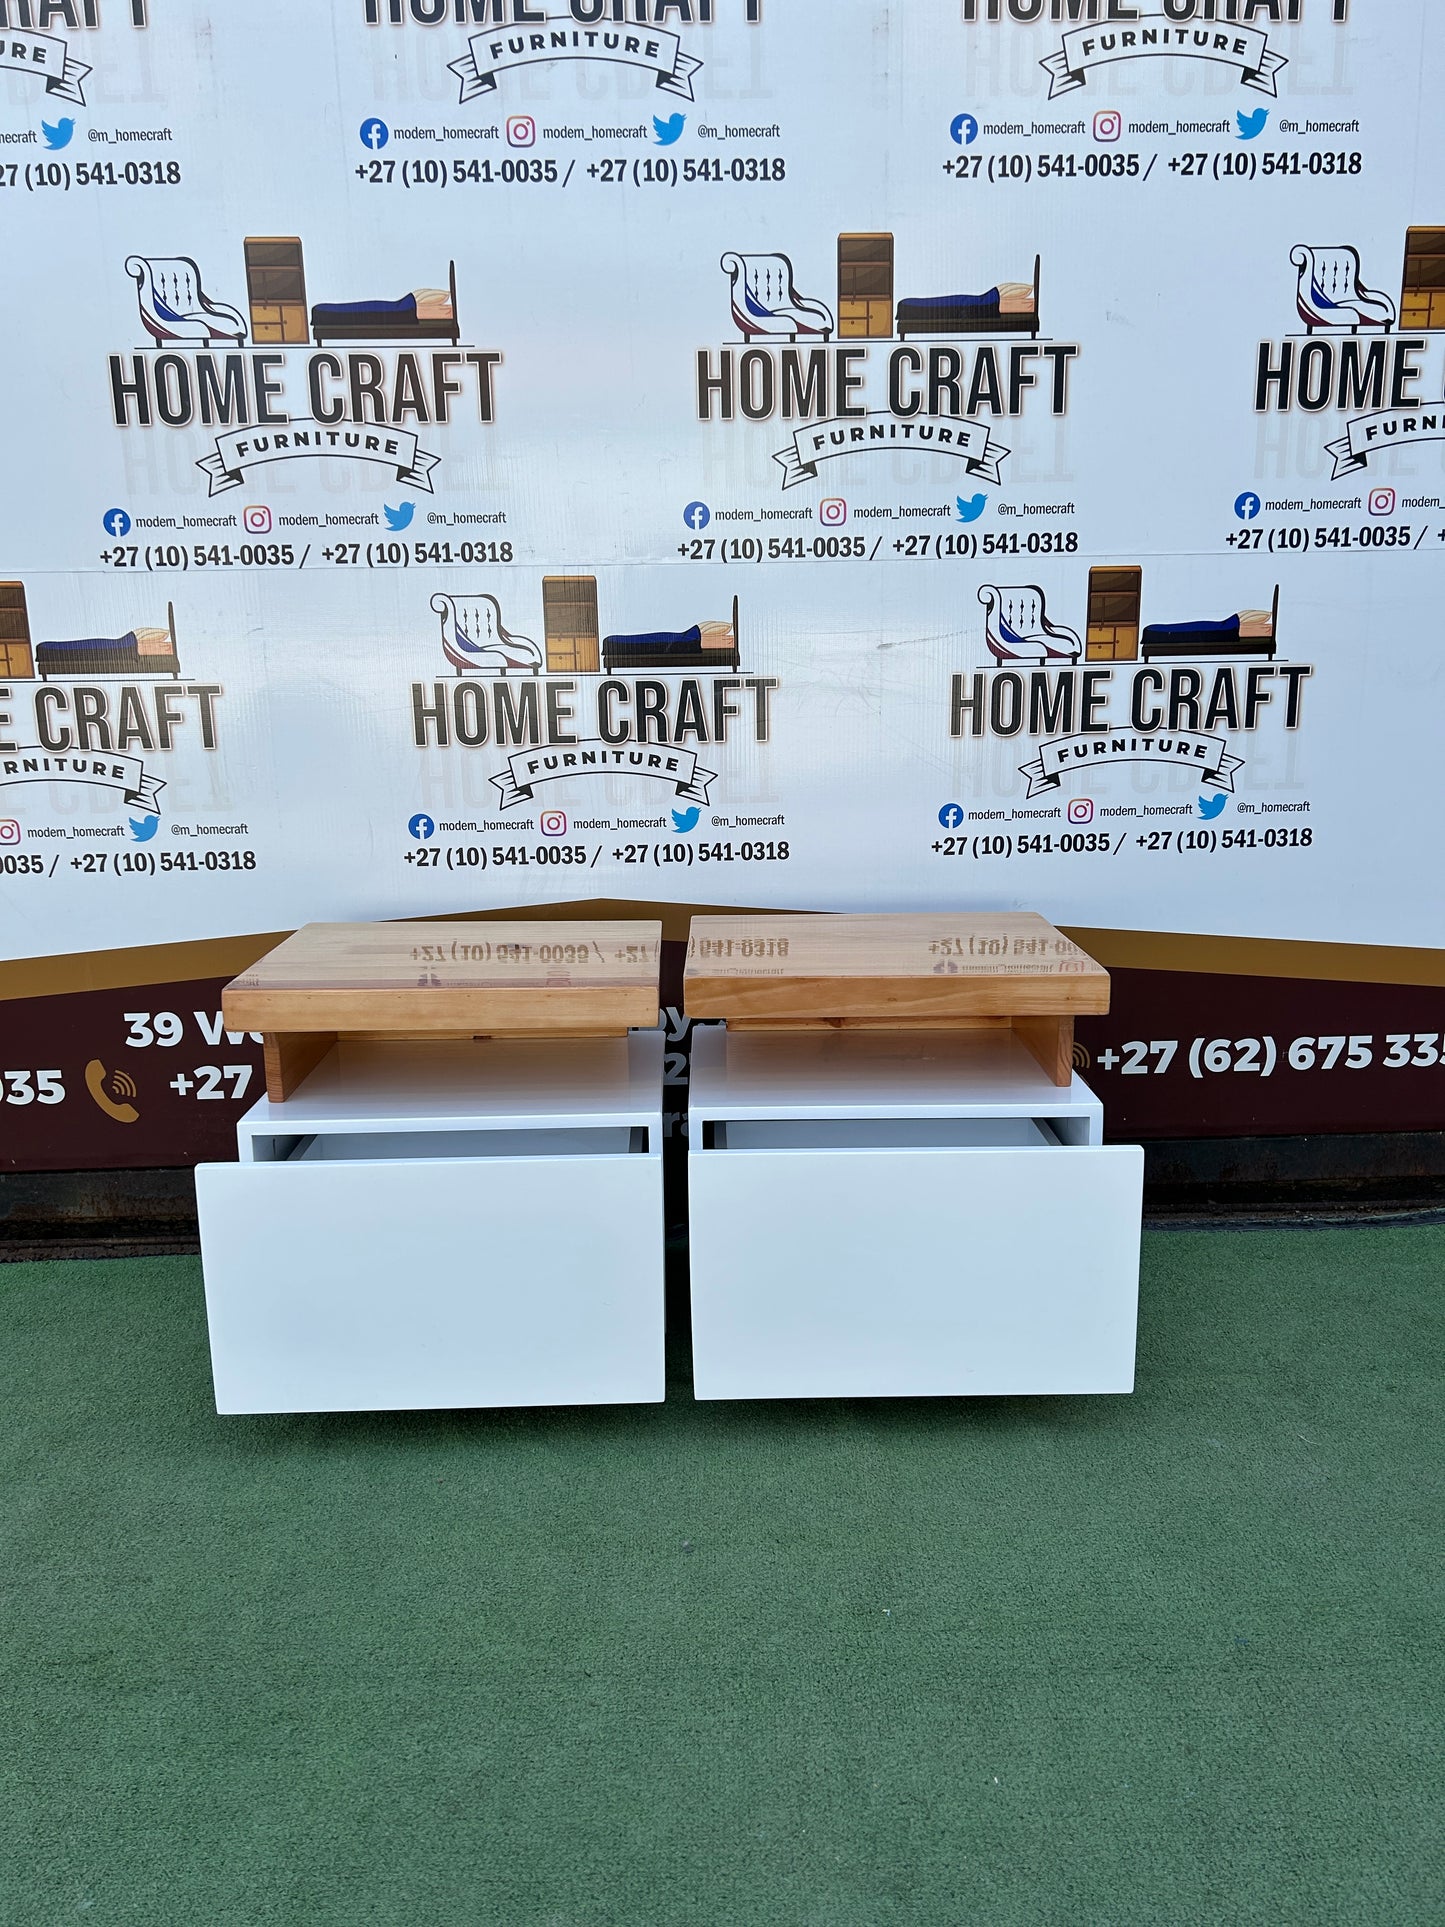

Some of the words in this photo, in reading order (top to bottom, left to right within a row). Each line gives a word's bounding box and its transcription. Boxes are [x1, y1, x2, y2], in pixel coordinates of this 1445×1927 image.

[489, 31, 660, 59] FURNITURE
[1082, 28, 1248, 56] FURNITURE
[88, 128, 172, 144] @m_homecraft
[698, 124, 780, 140] @m_homecraft
[1280, 120, 1359, 134] @m_homecraft
[25, 163, 70, 191] (10)
[76, 162, 180, 185] 541-0318
[355, 160, 395, 183] +27
[403, 160, 447, 188] (10)
[453, 160, 557, 183] 541-0035
[562, 160, 575, 187] /
[587, 159, 627, 182] +27
[633, 159, 677, 187] (10)
[683, 158, 785, 181] 541-0318
[943, 156, 982, 178] +27
[988, 155, 1031, 183] (10)
[1038, 154, 1139, 177] 541-0035
[1143, 154, 1158, 181] /
[1168, 153, 1208, 175] +27
[1213, 153, 1256, 180] (10)
[1262, 152, 1361, 175] 541-0318
[108, 353, 290, 426] HOME
[307, 351, 501, 424] CRAFT
[696, 348, 867, 420] HOME
[888, 345, 1078, 417] CRAFT
[1254, 339, 1427, 412] HOME
[236, 431, 399, 457] FURNITURE
[813, 424, 971, 451] FURNITURE
[427, 512, 506, 526] @m_homecraft
[998, 503, 1074, 517] @m_homecraft
[678, 540, 715, 559] +27
[721, 539, 762, 563] (10)
[768, 537, 865, 558] 541-0035
[869, 536, 882, 560] /
[893, 535, 930, 555] +27
[936, 534, 977, 559] (10)
[983, 532, 1078, 554] 541-0318
[1226, 529, 1263, 549] +27
[1268, 528, 1309, 553] (10)
[1314, 526, 1410, 547] 541-0035
[1414, 526, 1428, 550] /
[100, 547, 138, 567] +27
[145, 546, 188, 571] (10)
[194, 545, 294, 566] 541-0035
[299, 544, 310, 569] /
[322, 544, 360, 564] +27
[367, 543, 409, 568] (10)
[415, 542, 513, 563] 541-0318
[411, 681, 578, 747] HOME
[597, 678, 777, 745] CRAFT
[949, 670, 1111, 737] HOME
[1129, 665, 1311, 732] CRAFT
[33, 685, 222, 752] CRAFT
[528, 750, 679, 774] FURNITURE
[1058, 738, 1208, 762] FURNITURE
[712, 815, 785, 828] @m_homecraft
[1237, 801, 1310, 814] @m_homecraft
[171, 823, 248, 837] @m_homecraft
[932, 837, 967, 855] +27
[973, 836, 1012, 859] (10)
[1017, 833, 1109, 853] 541-0035
[1113, 833, 1127, 855] /
[1136, 832, 1172, 850] +27
[1177, 831, 1216, 853] (10)
[1222, 828, 1312, 848] 541-0318
[49, 855, 59, 877] /
[71, 854, 107, 872] +27
[114, 853, 155, 876] (10)
[161, 851, 256, 871] 541-0318
[404, 848, 440, 866] +27
[447, 847, 487, 870] (10)
[493, 846, 586, 865] 541-0035
[591, 846, 602, 868] /
[613, 845, 648, 863] +27
[654, 844, 693, 866] (10)
[699, 842, 789, 861] 541-0318
[124, 1012, 183, 1047] 39
[1098, 1041, 1178, 1074] +27
[1189, 1036, 1276, 1078] (62)
[1289, 1036, 1372, 1070] 675
[0, 1070, 65, 1105] 35
[170, 1065, 252, 1099] +27
